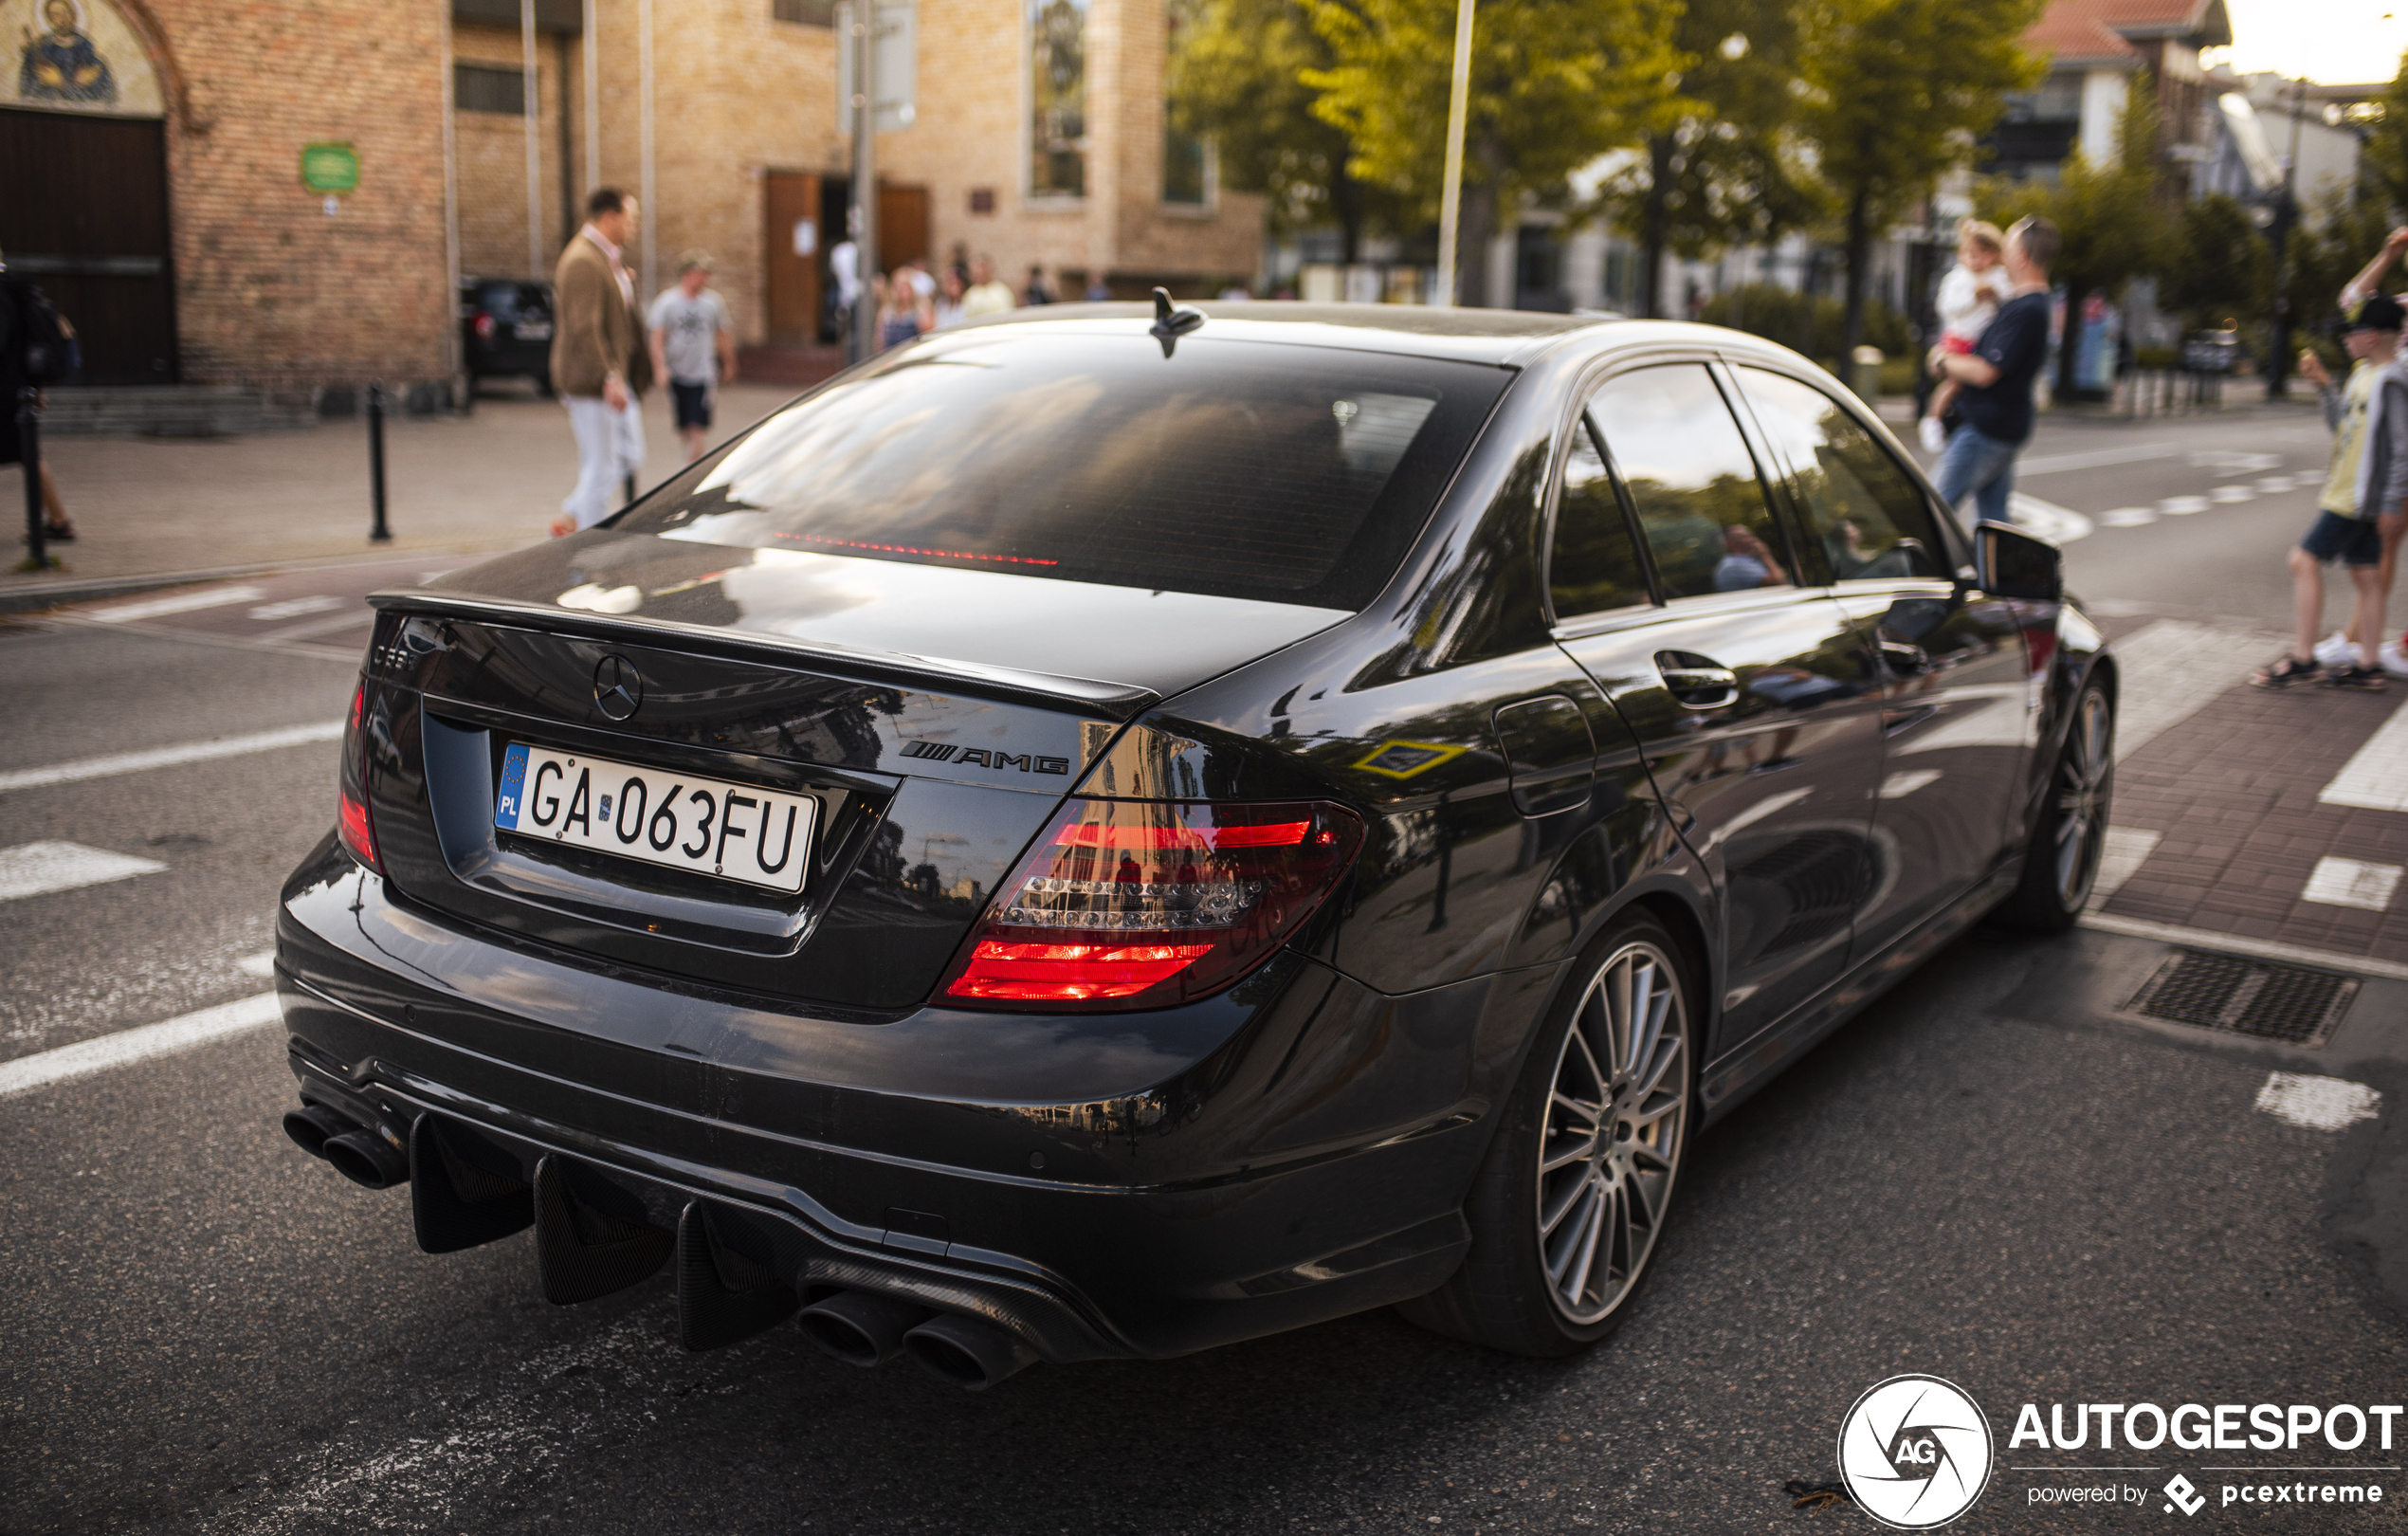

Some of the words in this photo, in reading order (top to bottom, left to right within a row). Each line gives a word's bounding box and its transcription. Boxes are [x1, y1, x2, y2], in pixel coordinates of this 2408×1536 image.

[500, 795, 517, 816] PL
[531, 760, 591, 837] GA
[615, 777, 797, 874] 063FU
